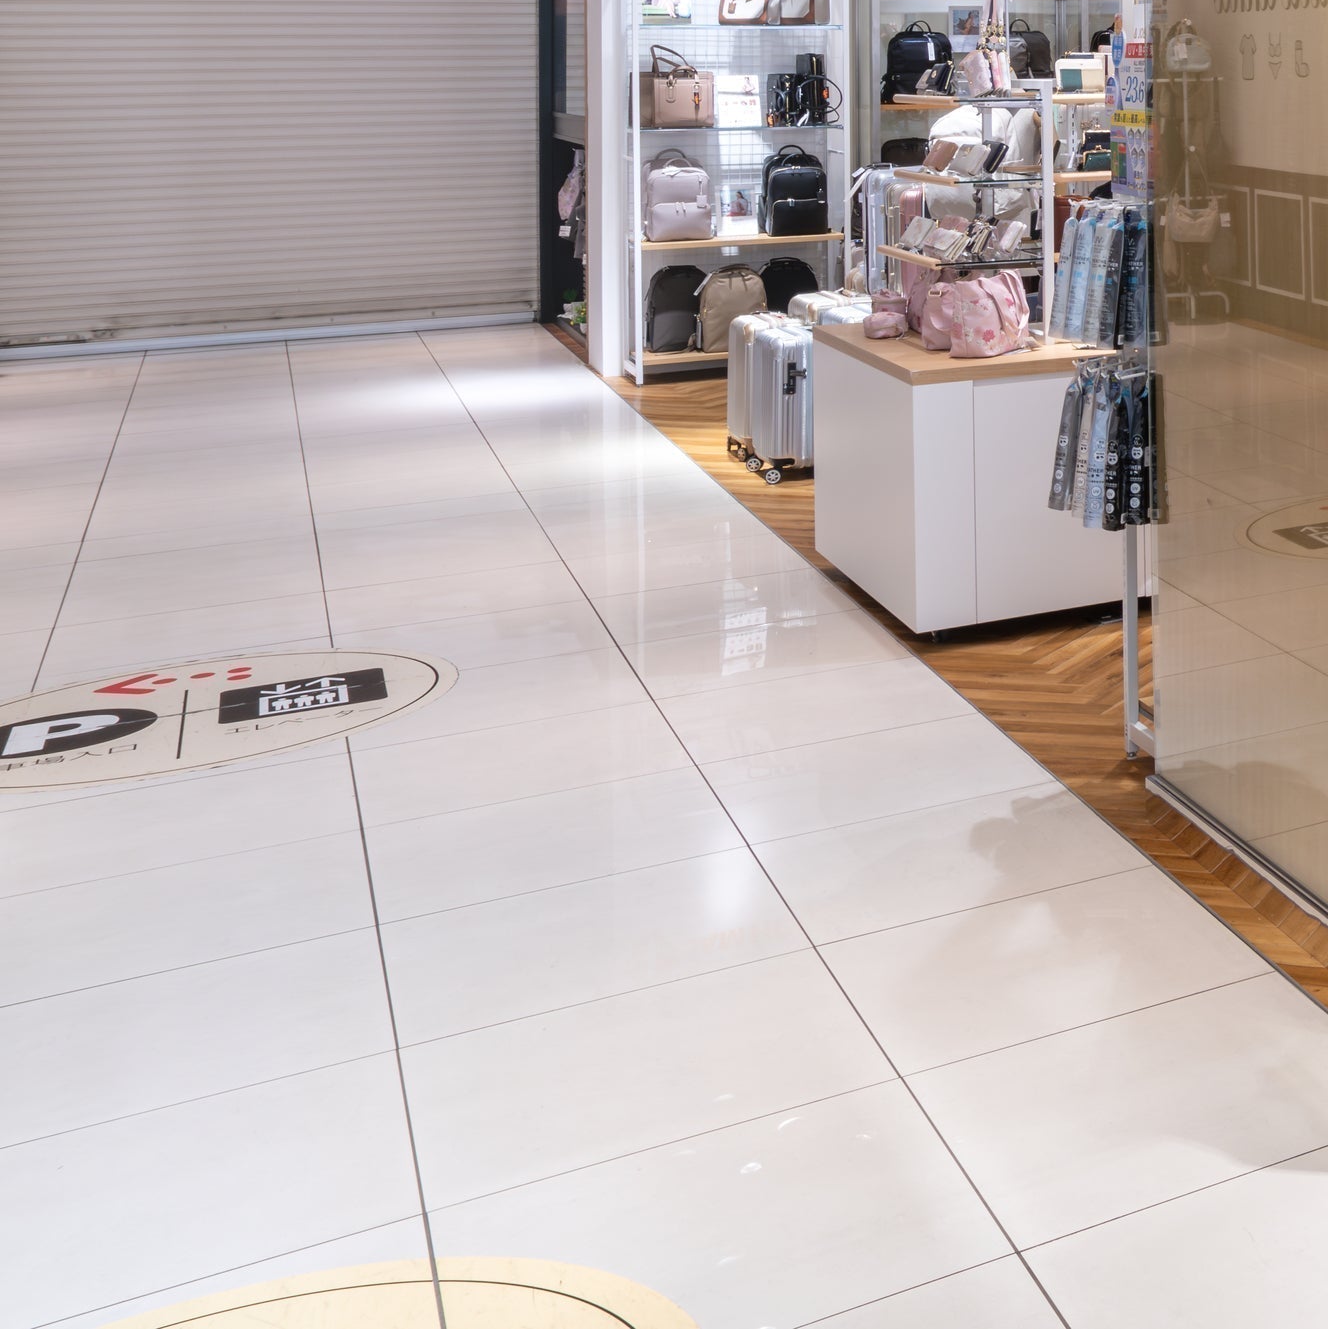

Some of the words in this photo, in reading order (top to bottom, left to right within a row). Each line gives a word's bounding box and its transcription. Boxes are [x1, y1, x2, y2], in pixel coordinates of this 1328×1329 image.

[2, 714, 120, 757] P
[224, 706, 386, 735] エレベーター
